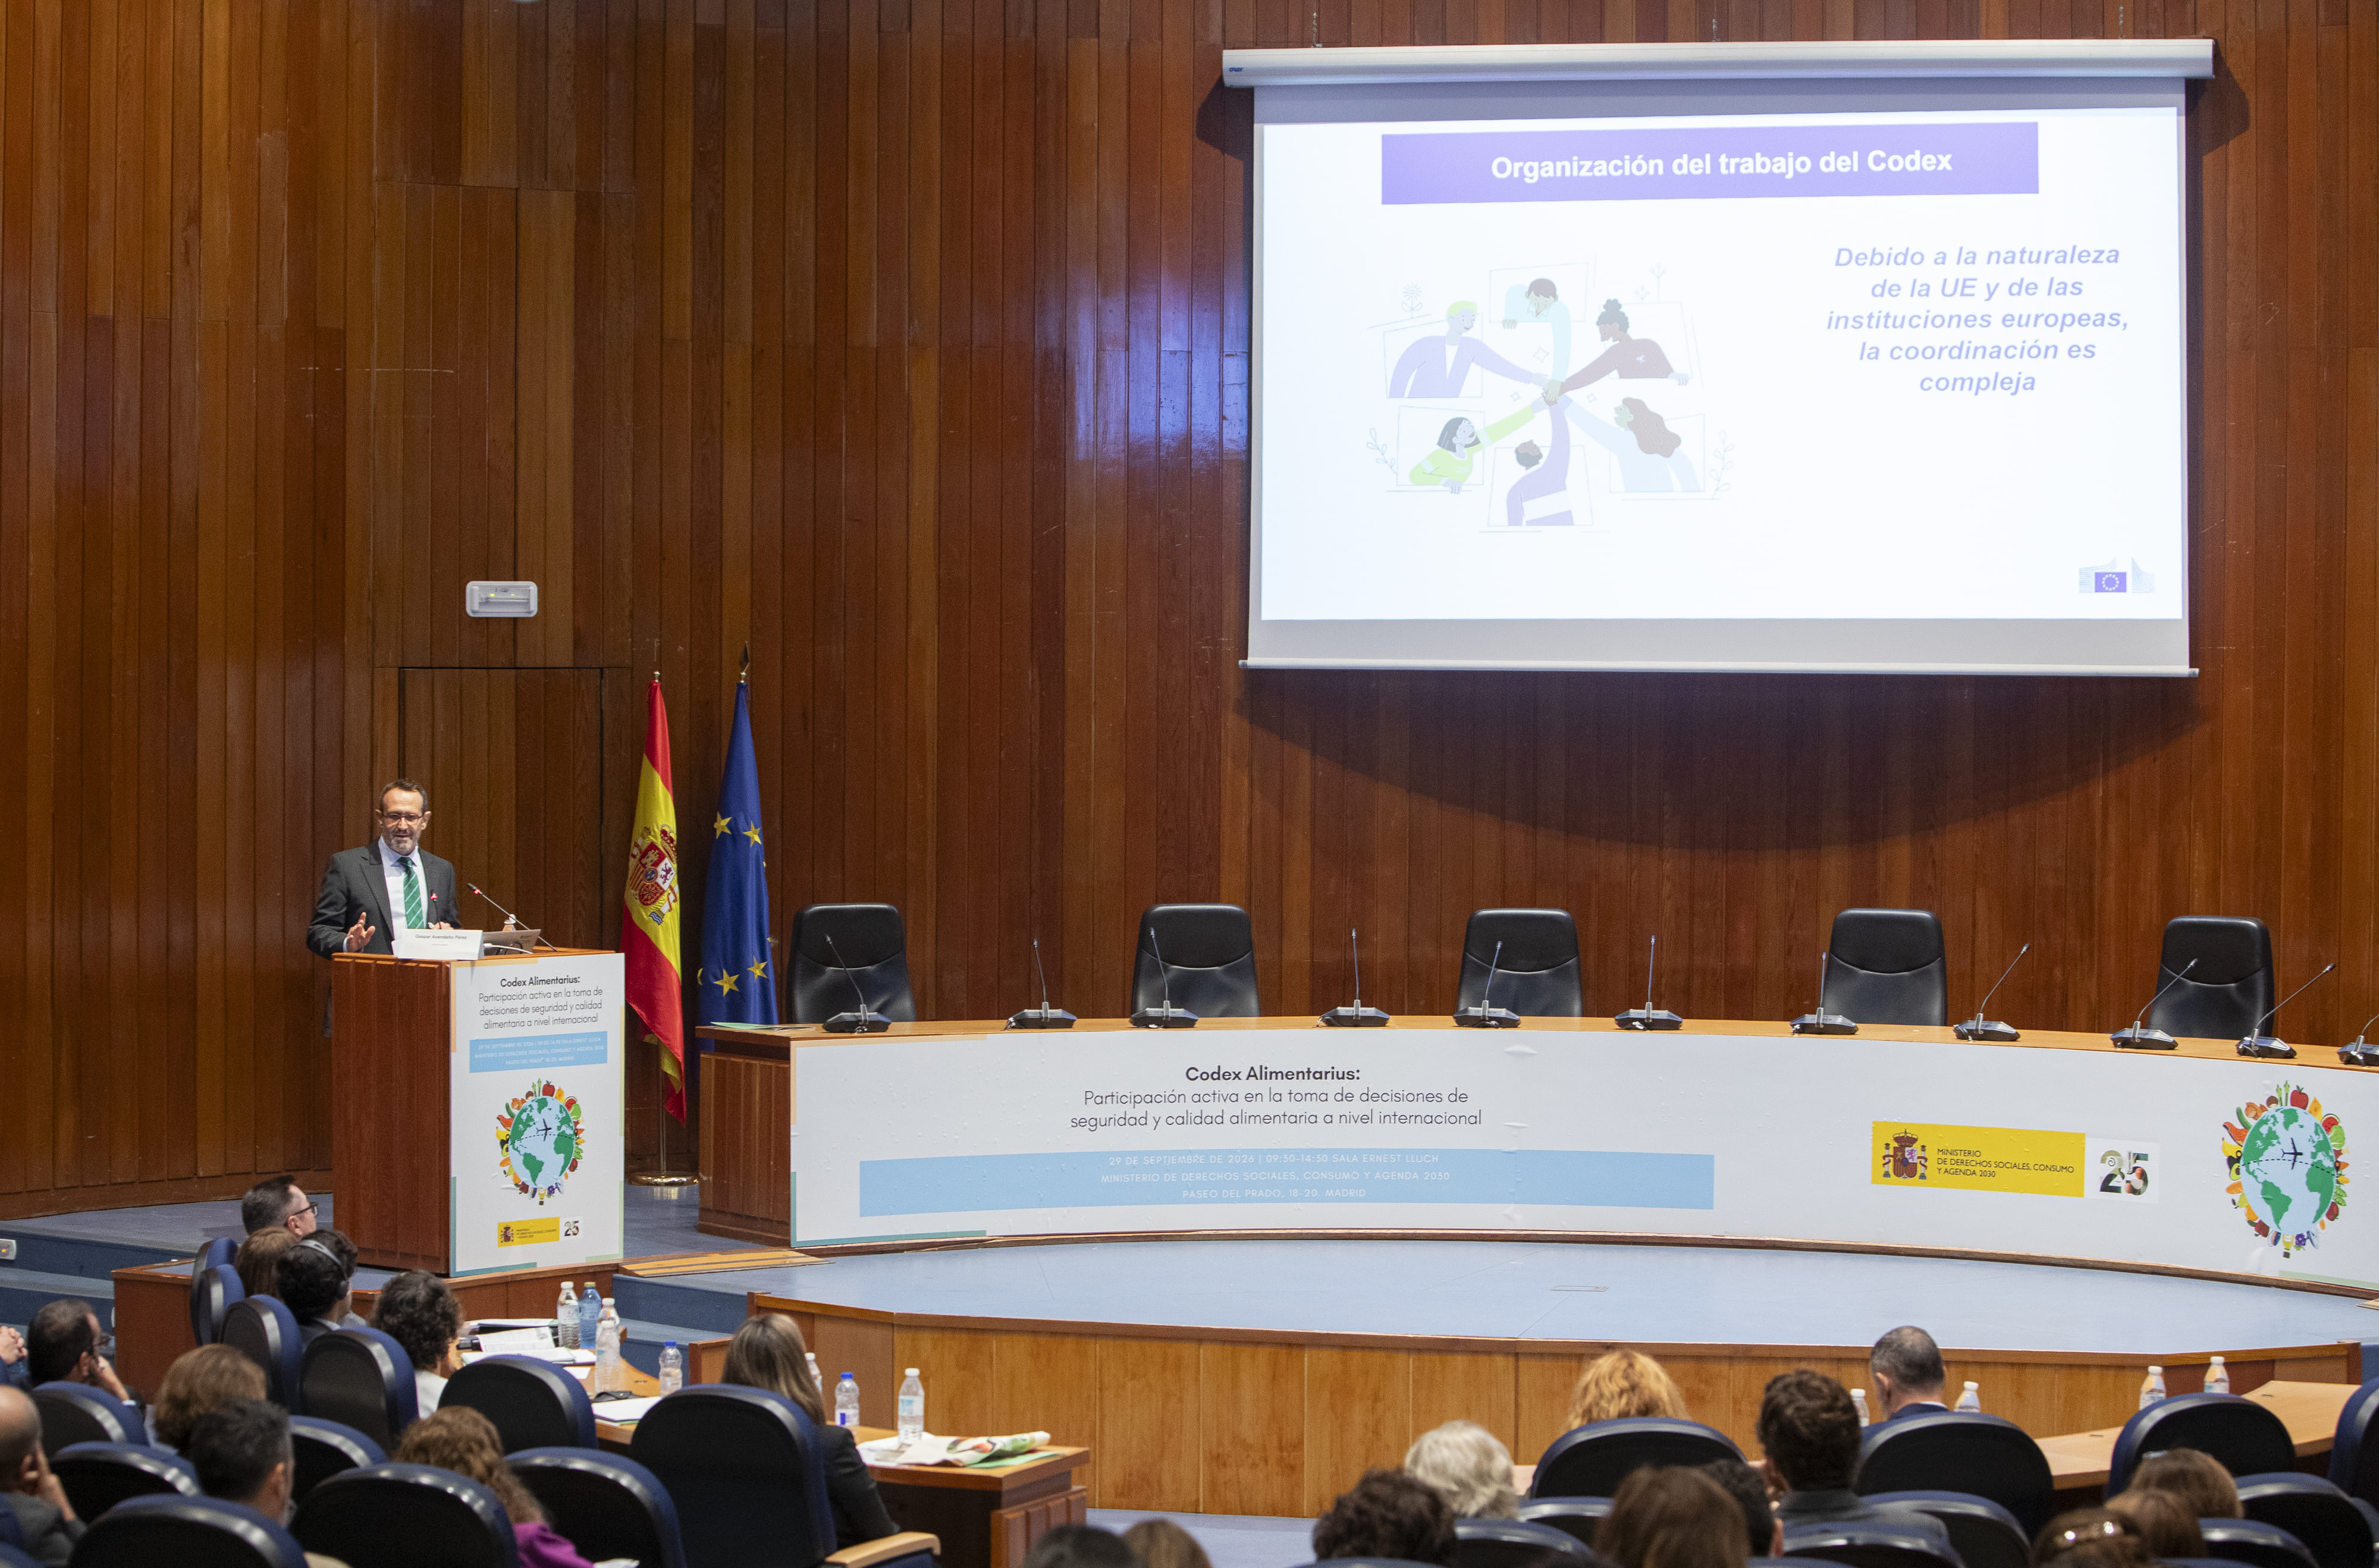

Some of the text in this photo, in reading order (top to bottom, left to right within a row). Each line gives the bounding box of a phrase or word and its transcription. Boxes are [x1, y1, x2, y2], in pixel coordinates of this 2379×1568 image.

[1492, 150, 1952, 183] Organización del trabajo del Codex
[1835, 245, 2119, 266] Debido a la naturaleza
[1872, 277, 2083, 301] de la UE y de las
[1827, 310, 2127, 332] instituciones europeas,
[1860, 340, 2096, 360] la coordinación es
[1920, 372, 2035, 396] compleja
[500, 976, 580, 987] Codex Alimentarius:
[479, 991, 526, 1003] Participación
[529, 991, 551, 999] activa
[564, 988, 570, 997] la
[594, 986, 602, 995] de
[479, 999, 602, 1016] decisiones de seguridad y calidad
[484, 1019, 525, 1029] alimentaria
[534, 1016, 550, 1026] nivel
[552, 1013, 598, 1025] internacional
[1186, 1065, 1360, 1081] Codex Alimentarius:
[1085, 1087, 1468, 1108] Participación activa en la toma de decisiones de
[1071, 1109, 1481, 1132] seguridad y calidad alimentaria a nivel internacional
[1109, 1157, 1121, 1165] 29
[1126, 1157, 1138, 1165] DE
[1143, 1154, 1204, 1165] SEPTIEMBRE
[1266, 1154, 1328, 1162] 09:30-14:30
[1332, 1154, 1358, 1162] SALA
[1363, 1154, 1401, 1162] ERNEST
[1938, 1149, 1981, 1157] MINISTERIO
[1950, 1158, 1992, 1167] DERECHOS
[2033, 1164, 2074, 1173] CONSUMO
[2099, 1149, 2149, 1195] 25
[1101, 1174, 1160, 1182] MINISTERIO
[1164, 1173, 1176, 1182] DE
[1182, 1172, 1239, 1181] DERECHOS
[1304, 1171, 1359, 1180] CONSUMO
[1374, 1171, 1418, 1180] AGENDA
[1183, 1190, 1218, 1198] PASEO
[1222, 1189, 1241, 1198] DEL
[1245, 1189, 1284, 1198] PRADO,
[564, 1220, 579, 1236] 25
